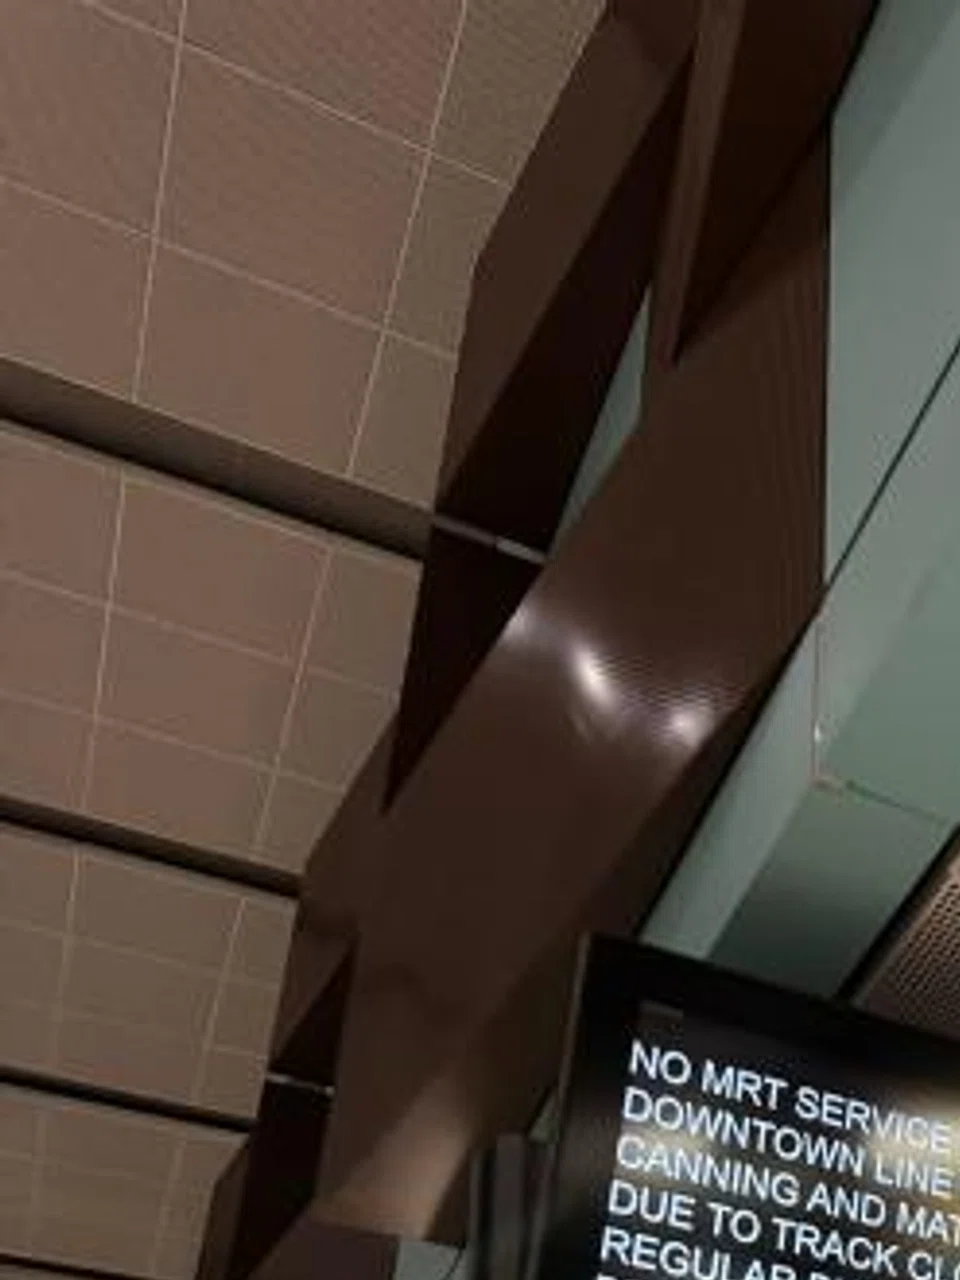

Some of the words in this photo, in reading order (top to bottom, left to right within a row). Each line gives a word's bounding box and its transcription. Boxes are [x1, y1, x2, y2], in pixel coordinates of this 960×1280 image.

[622, 1087, 864, 1177] DOWNTOWN
[874, 1148, 951, 1199] LINE
[630, 1040, 692, 1085] NO
[702, 1060, 787, 1110] MRT
[796, 1088, 951, 1155] SERVICE
[608, 1181, 695, 1230] DUE
[708, 1202, 762, 1243] TO
[772, 1217, 897, 1275] TRACK
[616, 1134, 799, 1203] CANNING
[806, 1183, 886, 1228] AND
